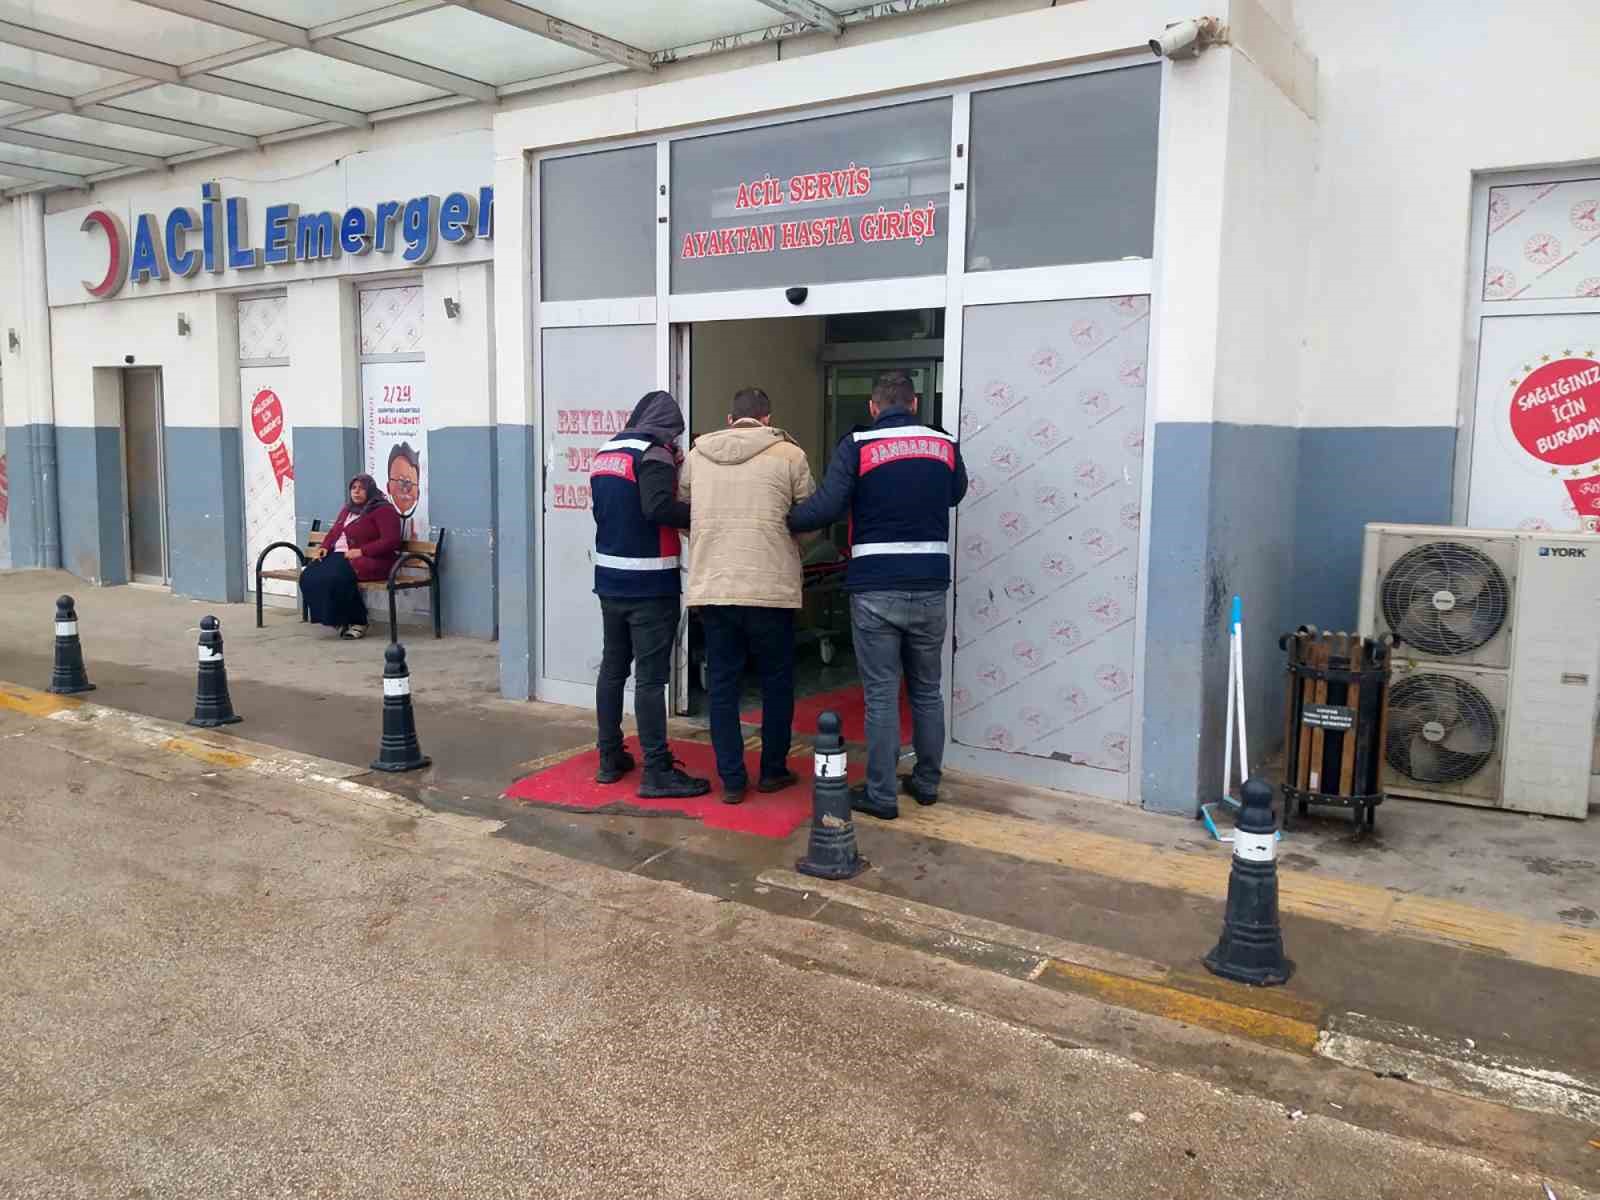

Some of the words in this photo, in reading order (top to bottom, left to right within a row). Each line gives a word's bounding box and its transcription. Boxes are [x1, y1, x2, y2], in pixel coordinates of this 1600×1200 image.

[735, 170, 784, 209] ACİL
[789, 161, 871, 203] SERVİS
[129, 182, 256, 284] ACİL
[680, 225, 775, 260] AYAKTAN
[781, 214, 854, 249] HASTA
[860, 200, 936, 246] GİRİŞİ
[1518, 365, 1600, 412] SAĞLIĞINIZ
[1551, 397, 1587, 424] İÇİN
[553, 484, 592, 510] HAS
[1551, 547, 1587, 558] YORK
